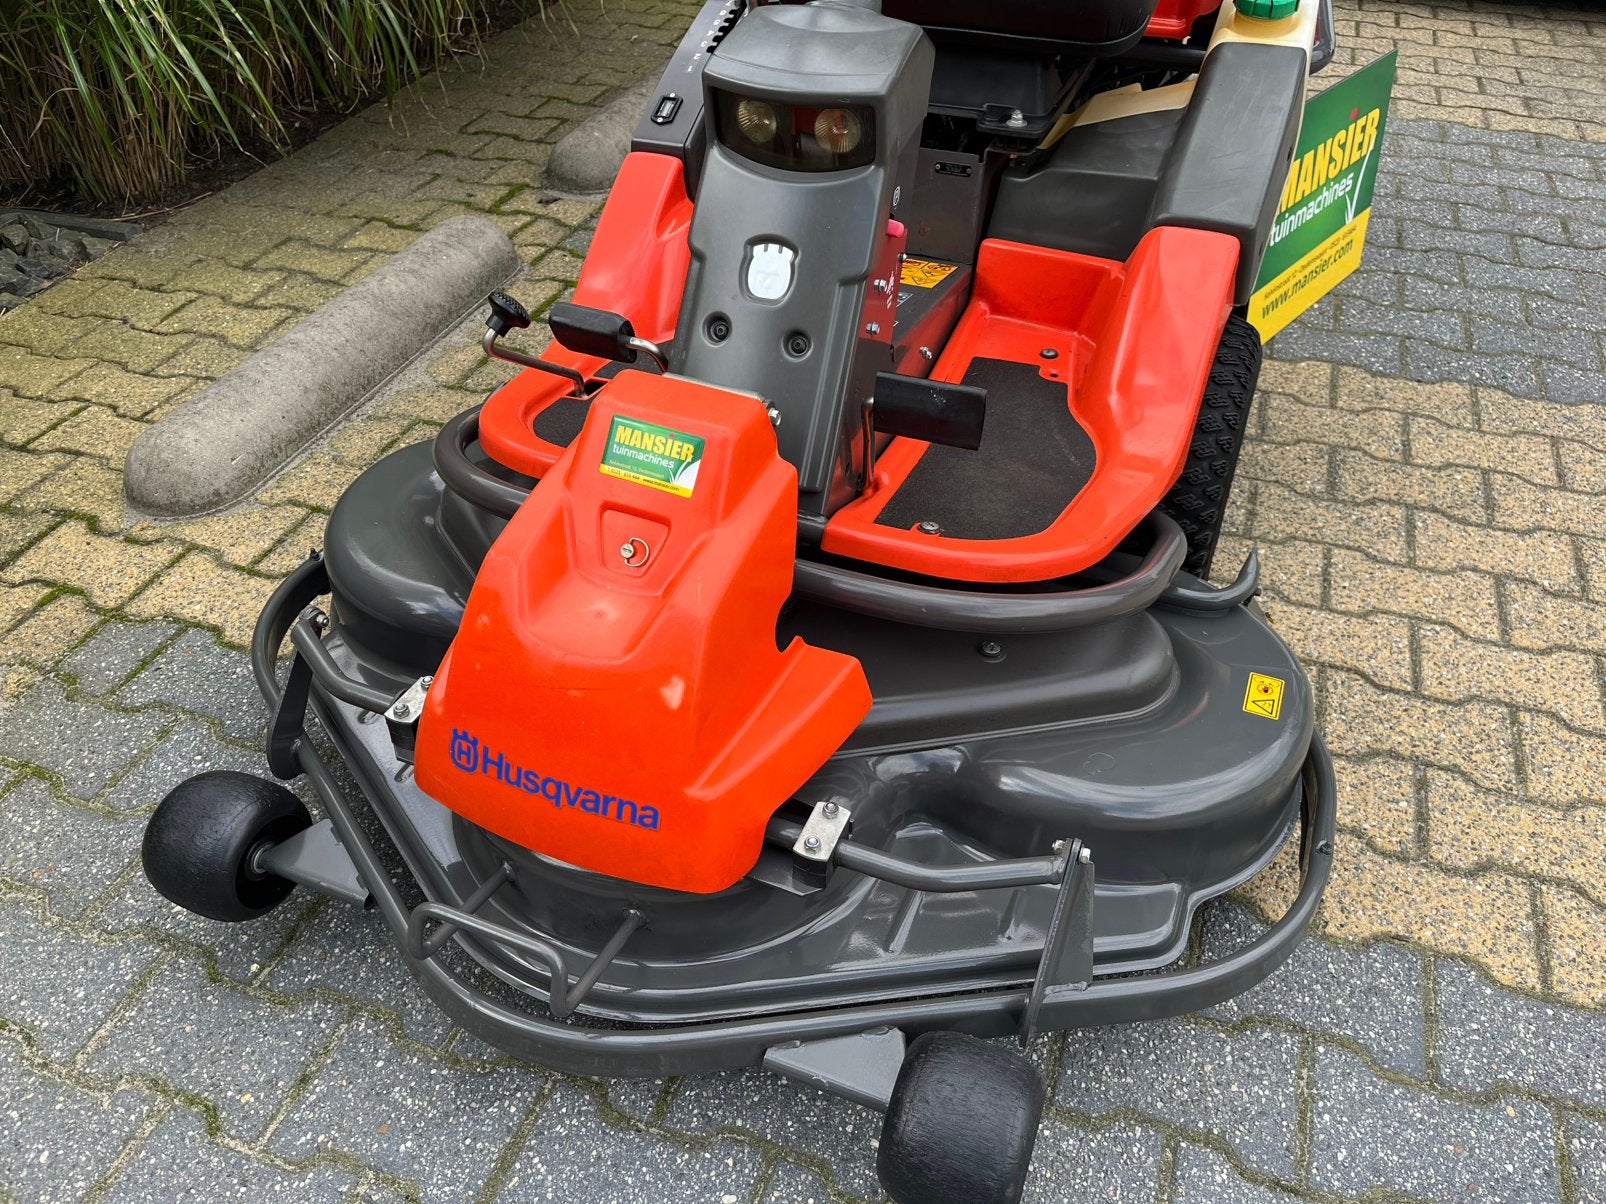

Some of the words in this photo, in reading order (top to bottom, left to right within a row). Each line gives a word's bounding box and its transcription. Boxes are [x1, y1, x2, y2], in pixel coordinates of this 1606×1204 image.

[1276, 107, 1381, 215] MANSIER
[1269, 172, 1354, 247] tuinmachines
[1262, 239, 1354, 320] www.mansier.com
[612, 443, 675, 469] tuinmachines
[614, 425, 695, 462] MANSIER
[481, 746, 661, 831] Husqvarna
